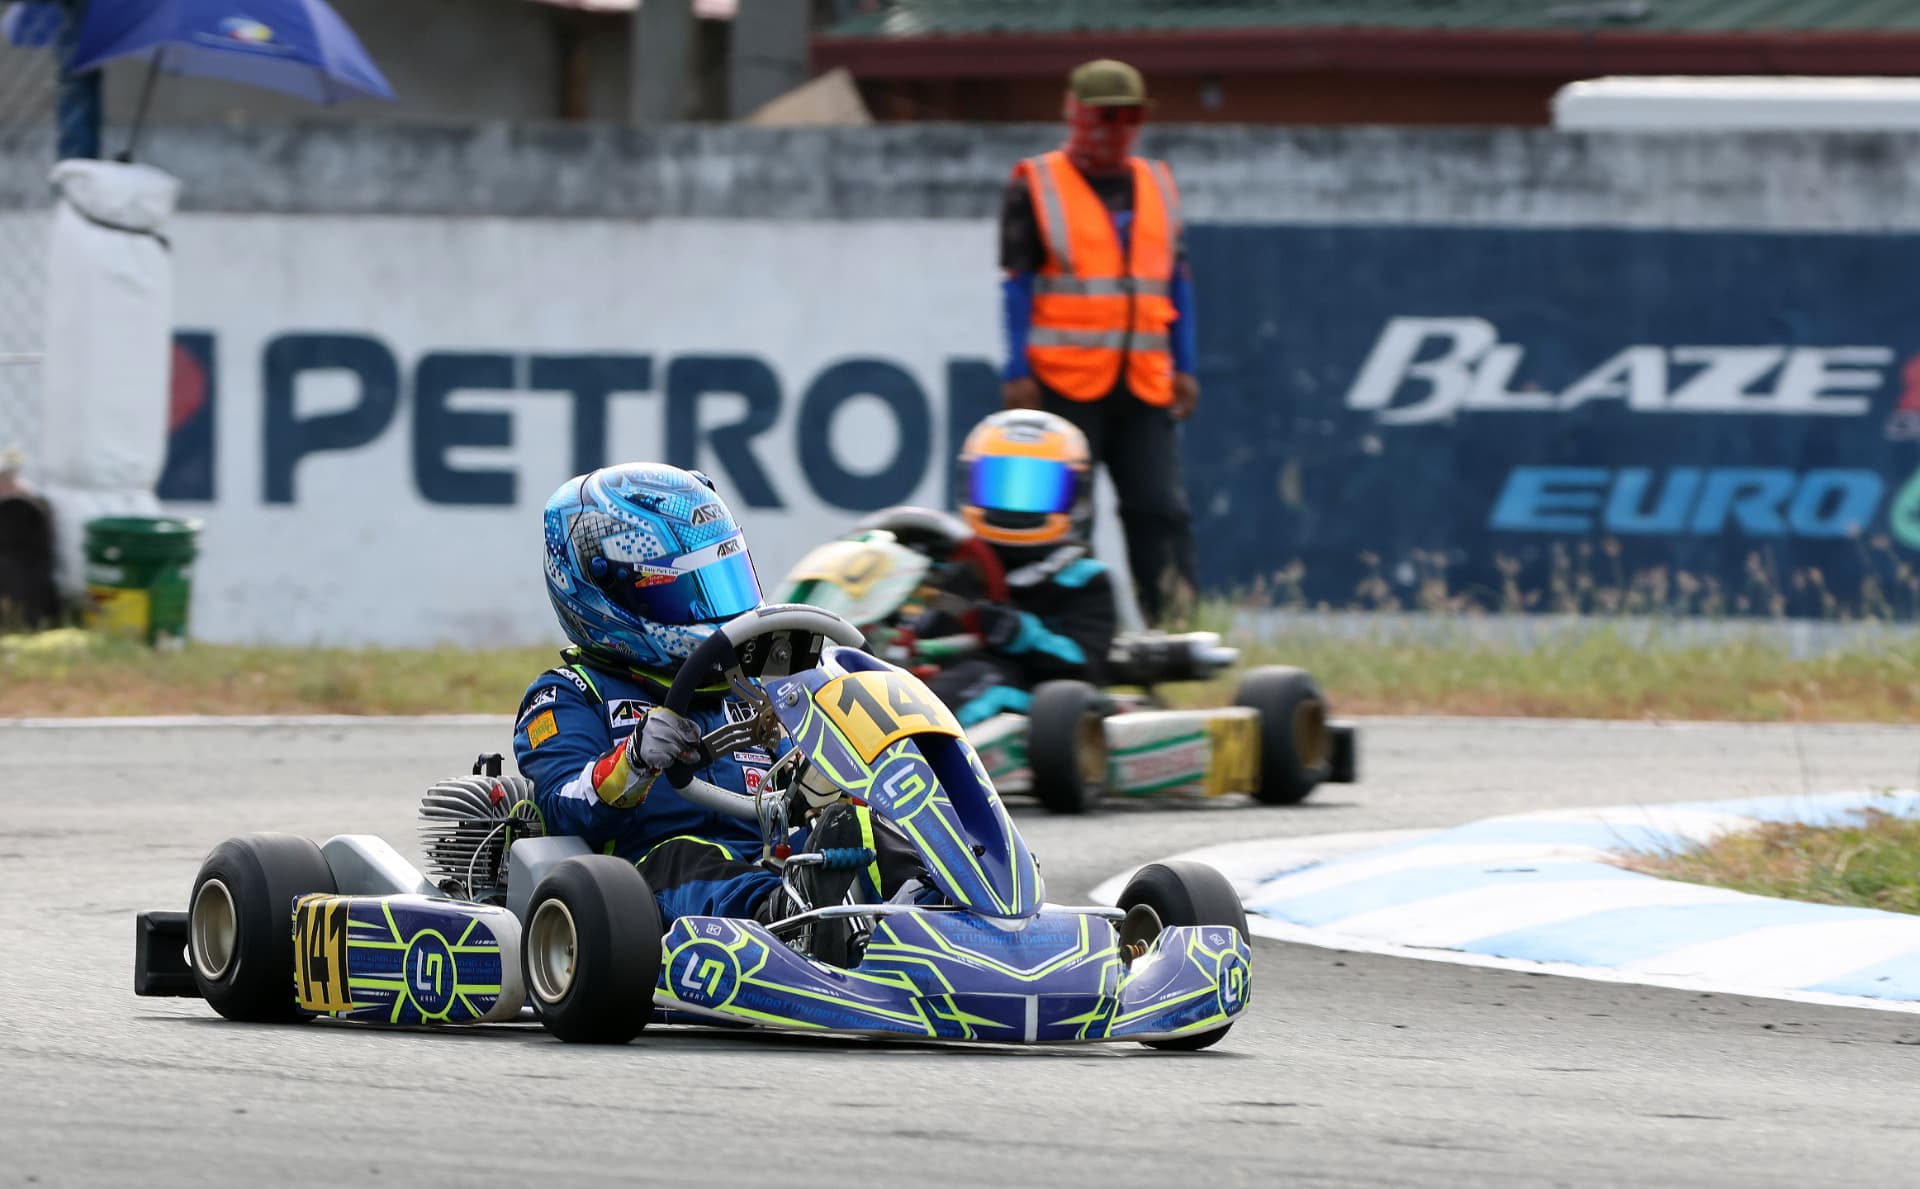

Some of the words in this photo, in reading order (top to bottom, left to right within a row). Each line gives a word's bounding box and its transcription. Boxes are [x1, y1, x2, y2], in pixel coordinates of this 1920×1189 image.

[1346, 315, 1893, 425] BLAZE
[1489, 465, 1885, 538] EURO
[553, 667, 588, 692] parco
[611, 700, 651, 721] AS
[836, 675, 940, 736] 14
[295, 898, 351, 1005] 141
